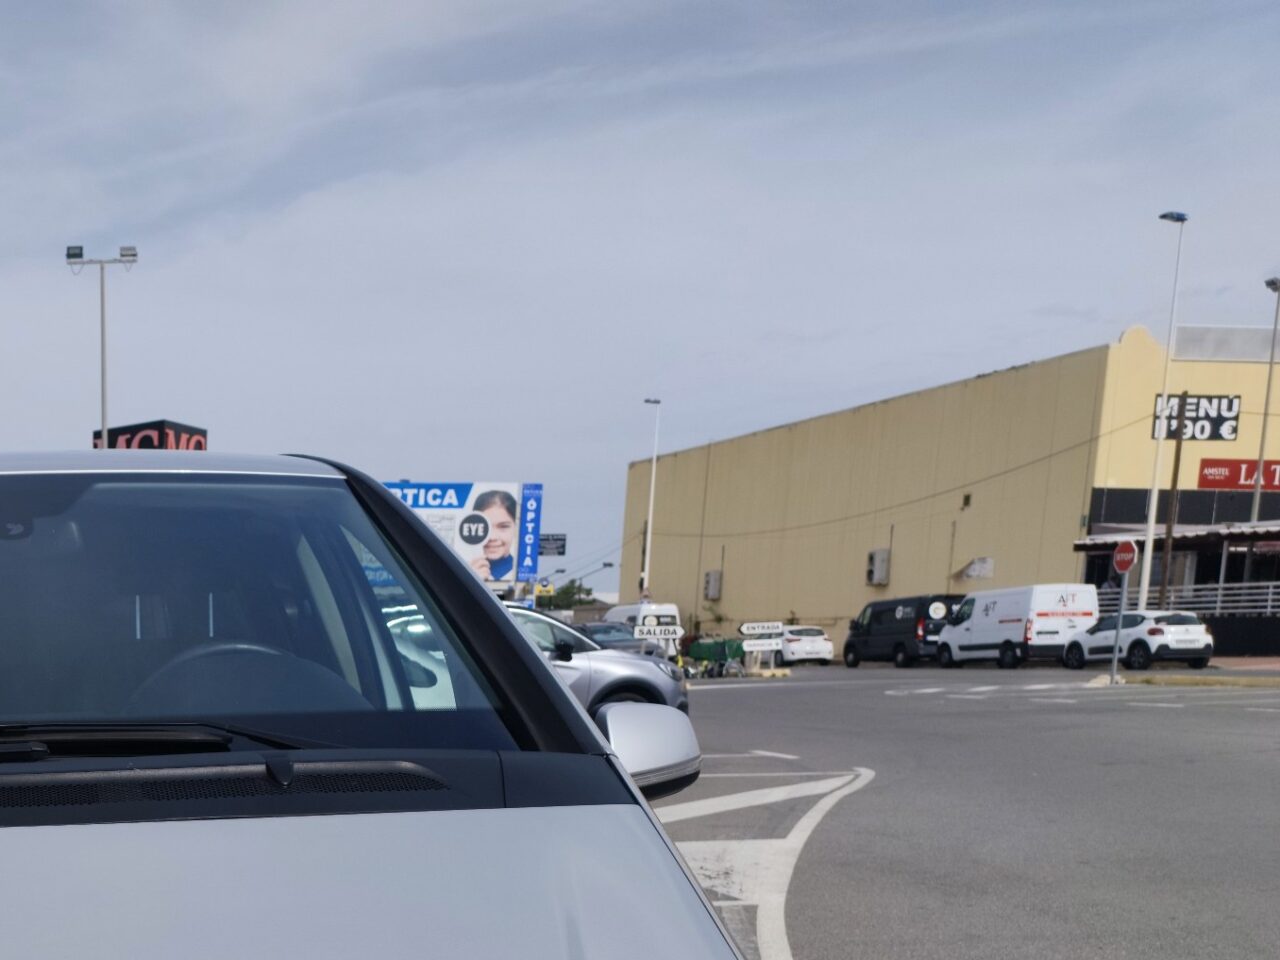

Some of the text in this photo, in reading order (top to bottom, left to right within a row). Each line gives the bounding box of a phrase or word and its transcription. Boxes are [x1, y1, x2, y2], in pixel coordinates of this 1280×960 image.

[1219, 420, 1237, 440] €
[463, 523, 484, 536] EYE
[638, 628, 677, 636] SALIDA
